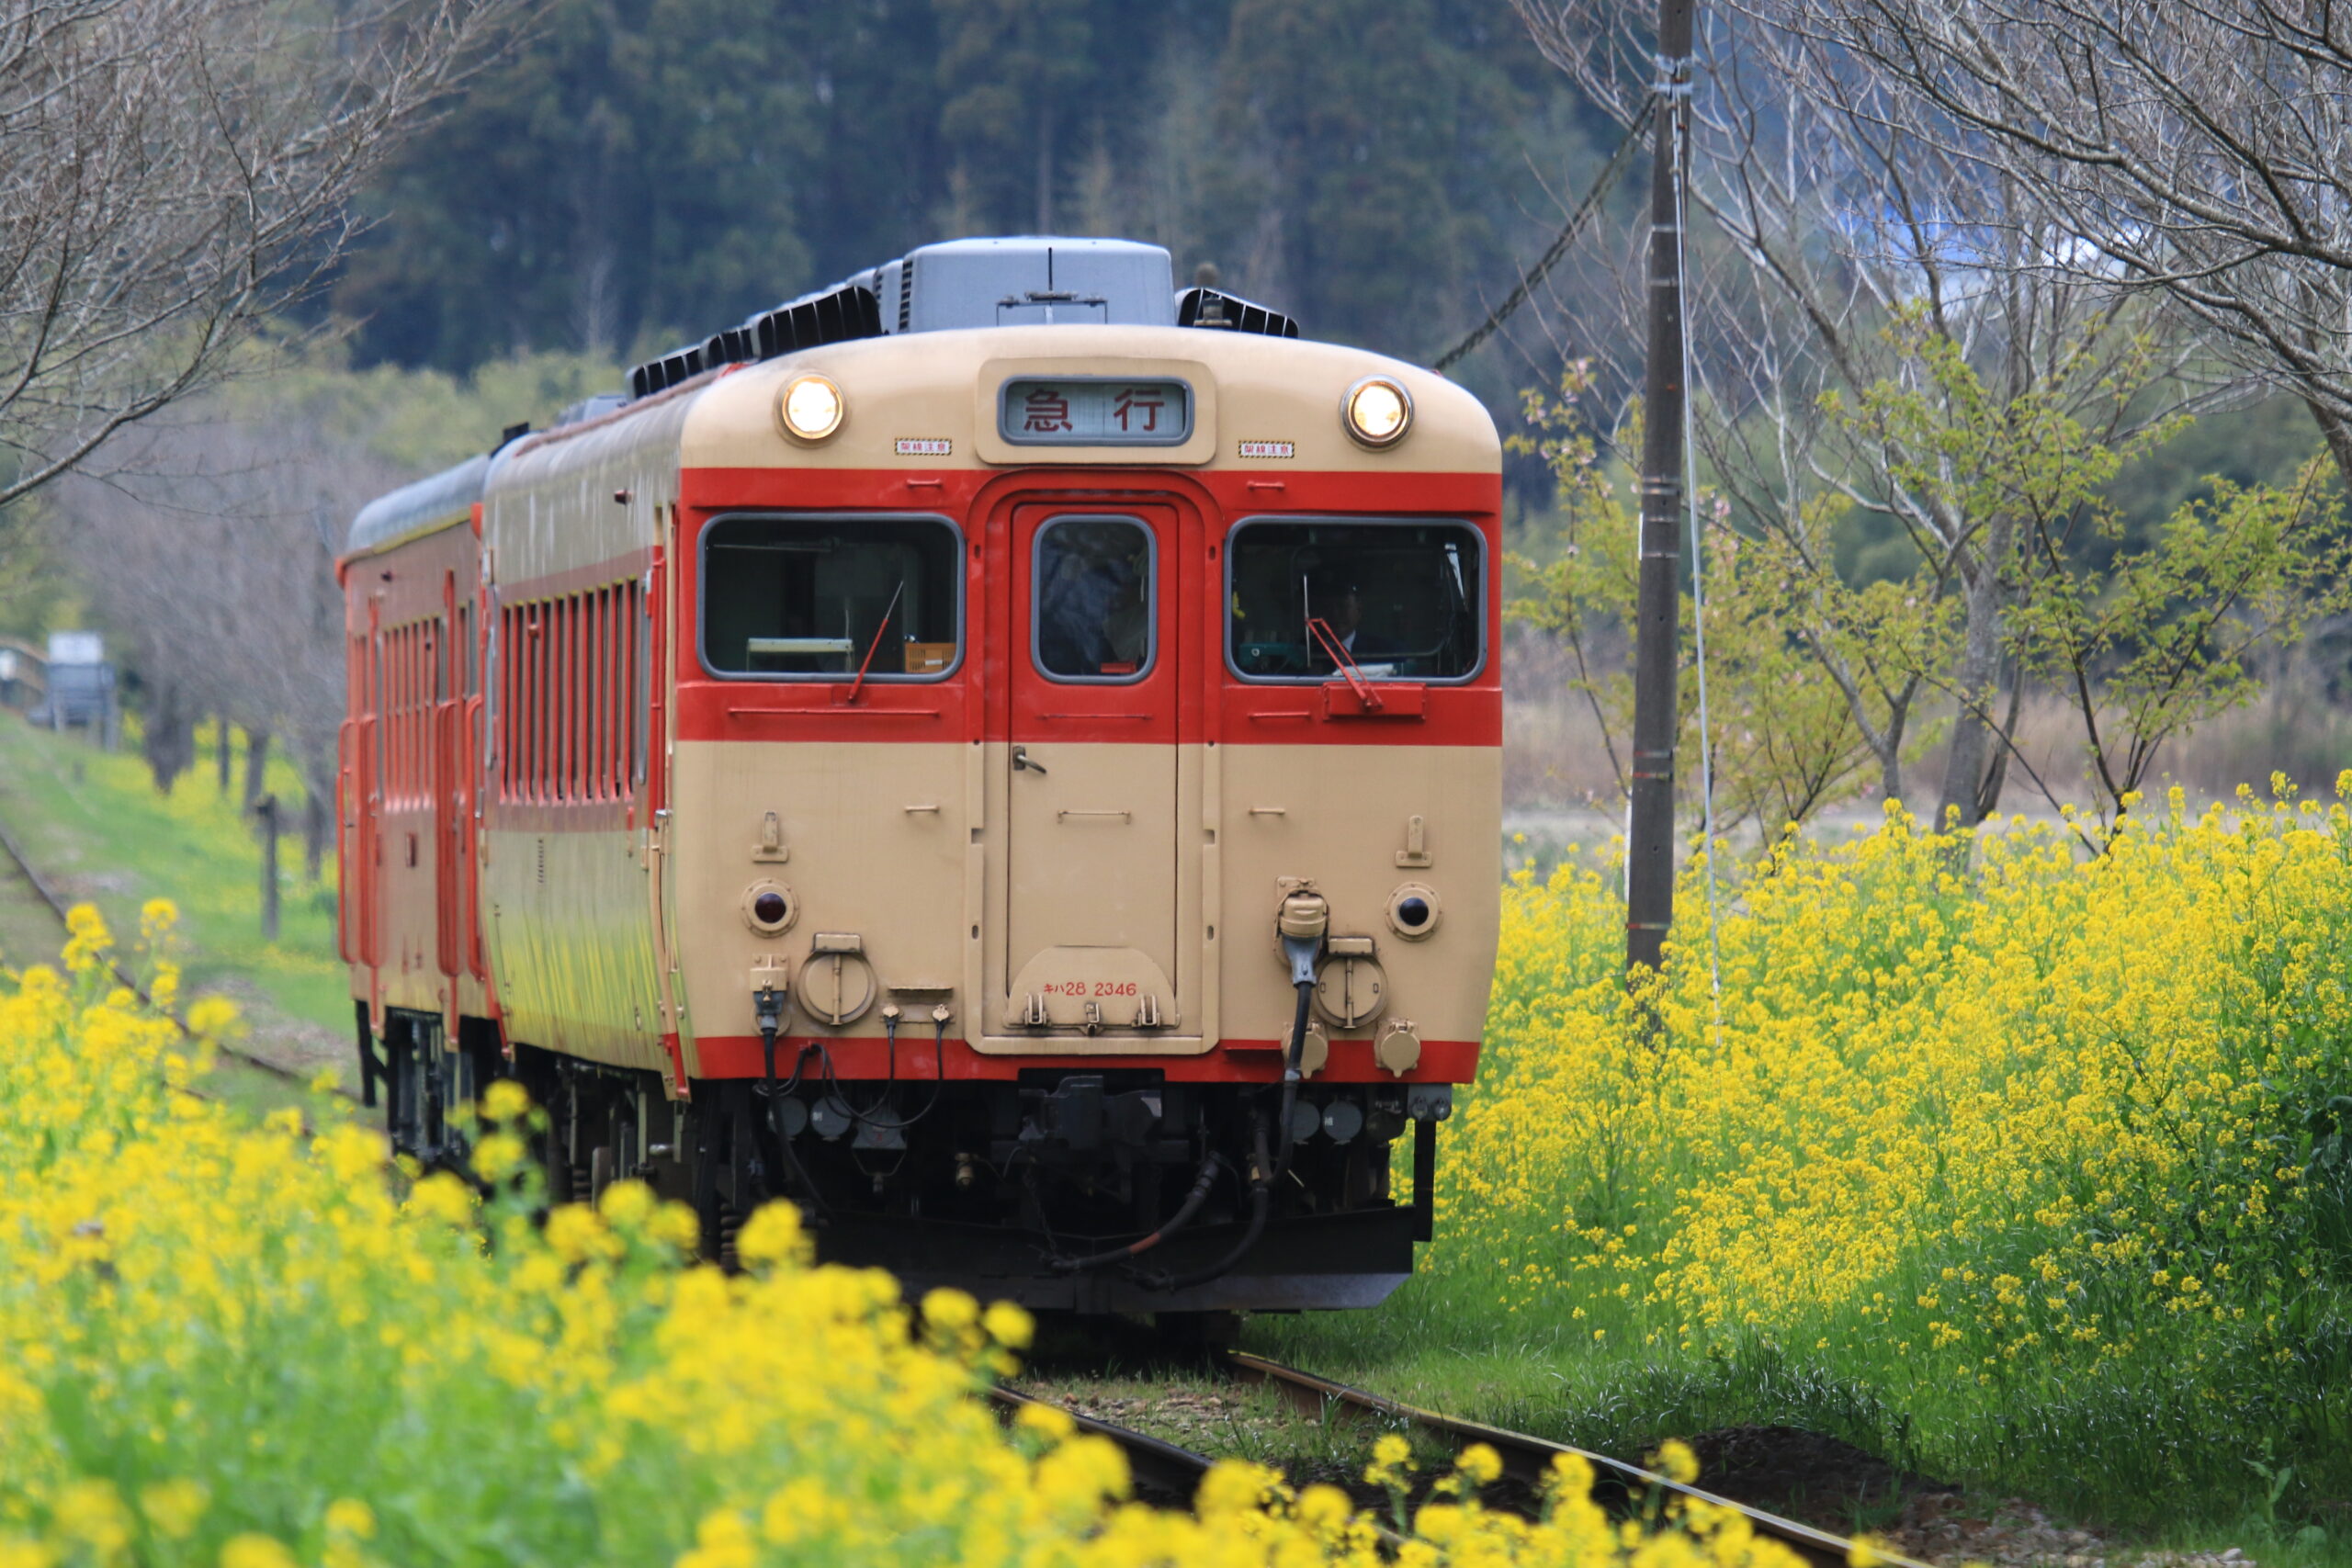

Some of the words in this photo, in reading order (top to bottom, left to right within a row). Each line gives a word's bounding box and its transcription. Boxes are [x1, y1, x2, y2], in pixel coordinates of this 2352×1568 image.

[1023, 389, 1165, 432] 急行
[1044, 982, 1087, 997] キハ28
[1094, 983, 1137, 998] 2346
